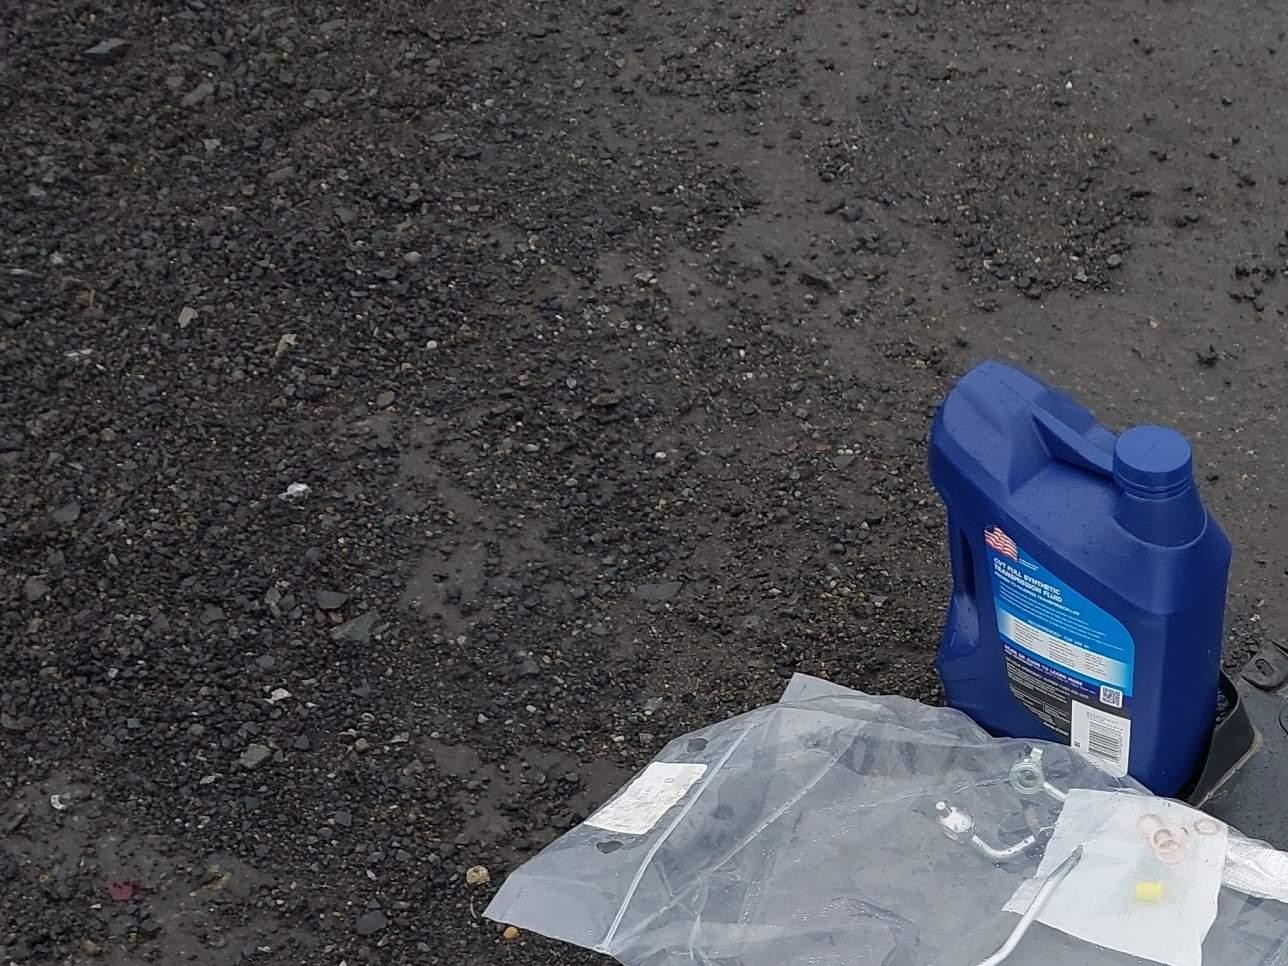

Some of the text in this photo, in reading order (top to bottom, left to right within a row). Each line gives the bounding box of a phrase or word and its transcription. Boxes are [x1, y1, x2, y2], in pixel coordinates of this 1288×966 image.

[994, 557, 1006, 568] CVT
[994, 563, 1042, 593] TRANSMISSION
[1043, 590, 1063, 603] FLUID
